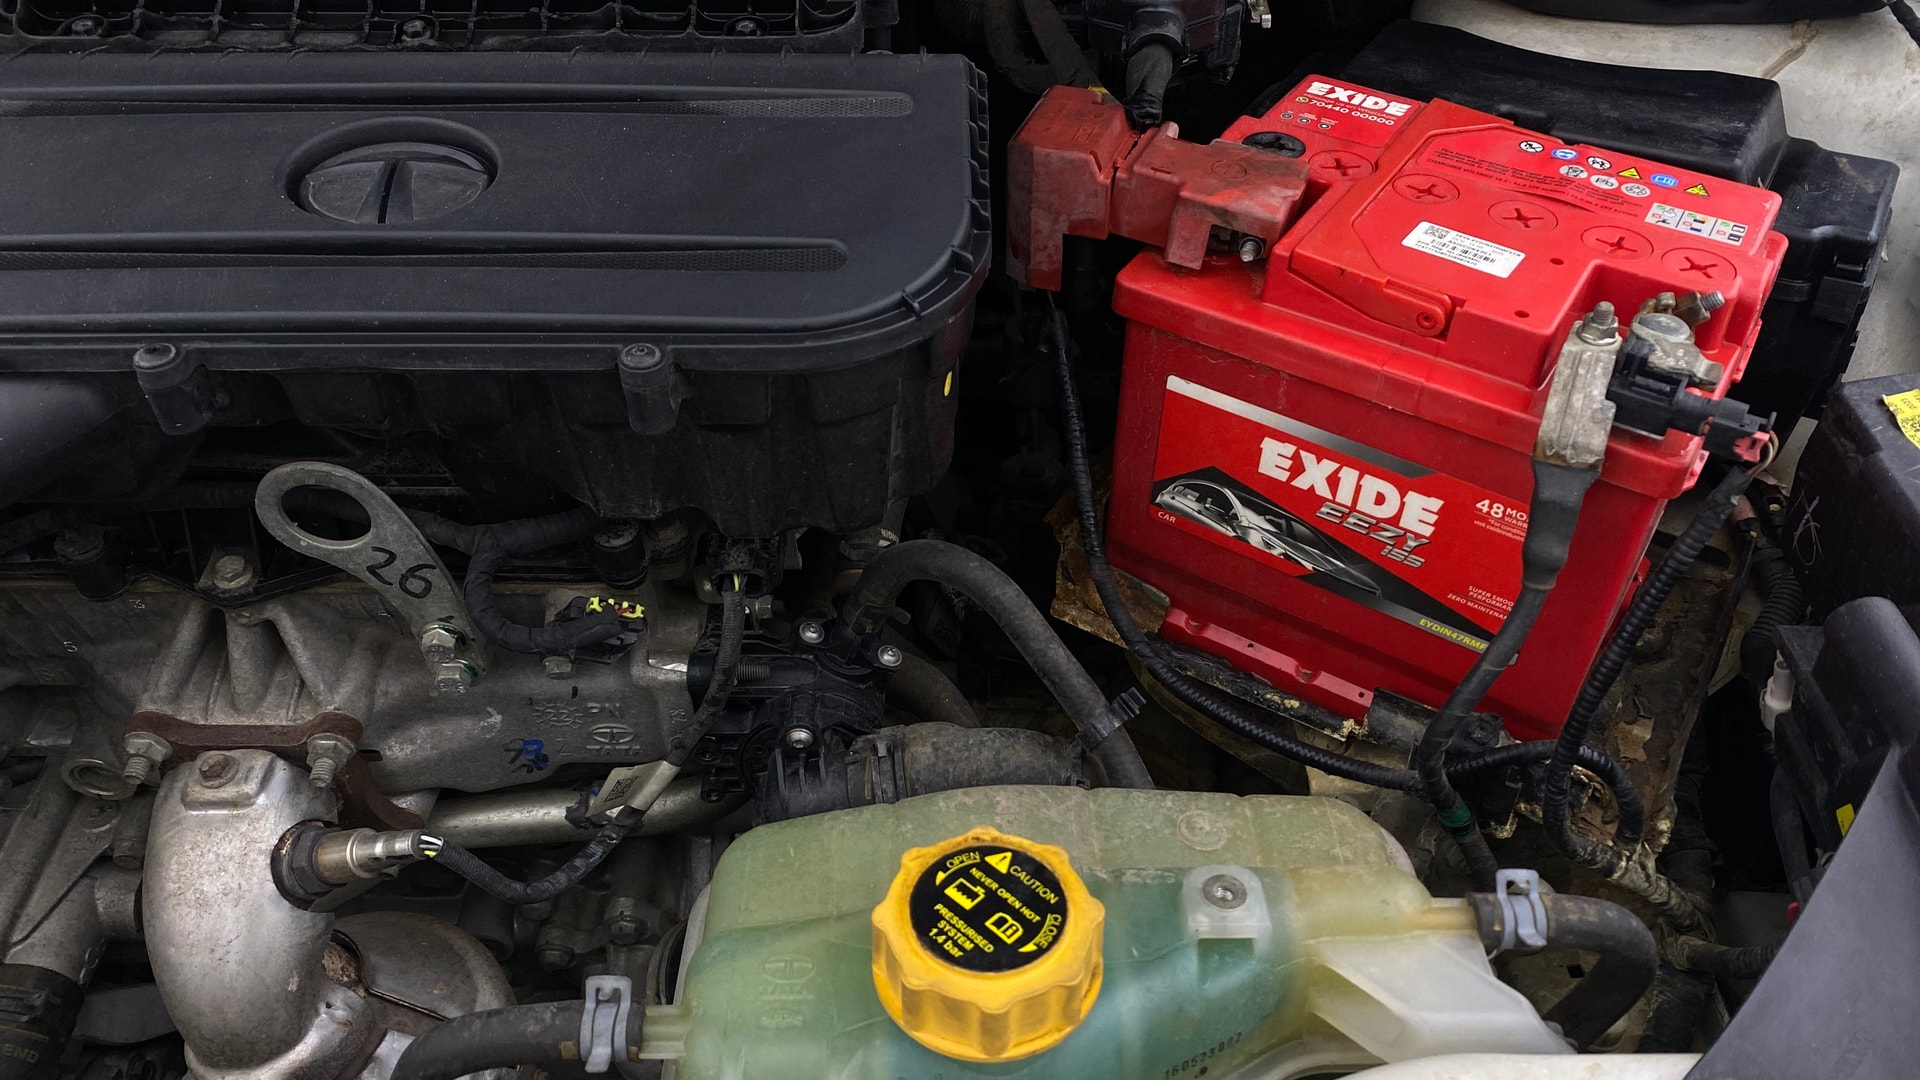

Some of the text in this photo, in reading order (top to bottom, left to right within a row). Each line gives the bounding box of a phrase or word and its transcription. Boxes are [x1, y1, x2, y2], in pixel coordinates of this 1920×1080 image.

[1306, 81, 1412, 117] EXIDE
[1309, 99, 1349, 114] 70440
[1351, 110, 1394, 125] 00000
[1258, 437, 1444, 537] EXIDE
[1157, 511, 1176, 523] CAR
[1315, 501, 1431, 551] EEZY
[1475, 499, 1529, 522] 48 MO
[366, 546, 437, 599] 26
[1447, 593, 1467, 604] ZERO
[1468, 585, 1492, 598] SUPER
[946, 851, 980, 869] OPEN
[969, 867, 1042, 924] NEVER OPEN HOT
[1009, 865, 1060, 904] CAUTION
[928, 928, 964, 958] 1.4 bar
[933, 903, 995, 954] PRESSURISED
[937, 920, 975, 952] SYSTEM
[1036, 913, 1062, 949] CLOSE
